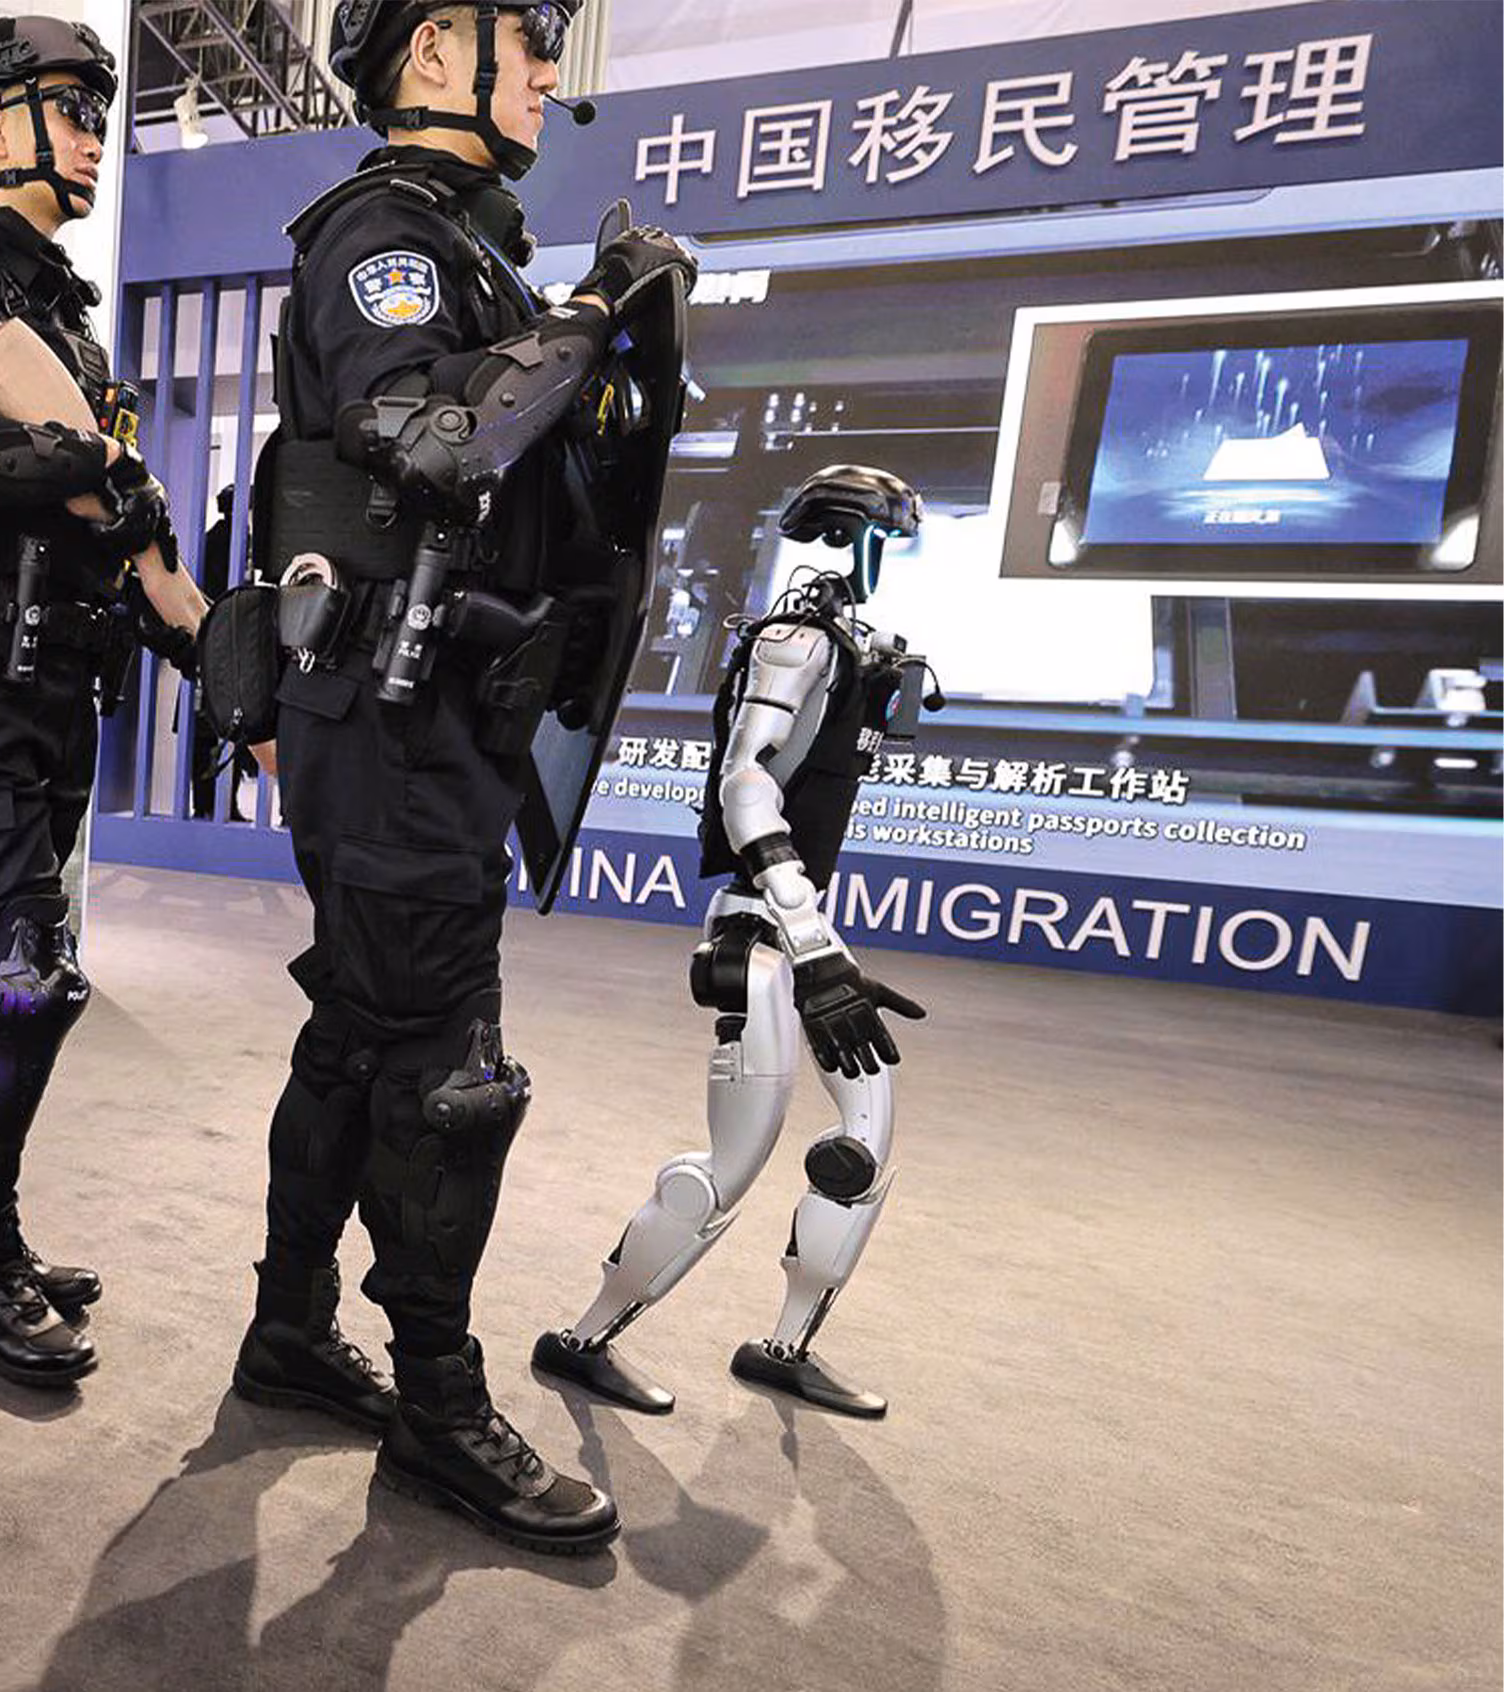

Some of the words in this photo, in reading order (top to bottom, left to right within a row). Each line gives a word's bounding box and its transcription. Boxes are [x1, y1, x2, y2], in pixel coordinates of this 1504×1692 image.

[634, 33, 1374, 205] 中国移民管理
[617, 736, 713, 771] 研发配
[846, 818, 868, 840] is
[872, 823, 1034, 855] workstations
[893, 798, 1022, 829] intelligent
[1027, 808, 1158, 839] passports
[1163, 818, 1307, 850] collection
[504, 841, 687, 909] INA
[822, 871, 1372, 983] MIGRATION
